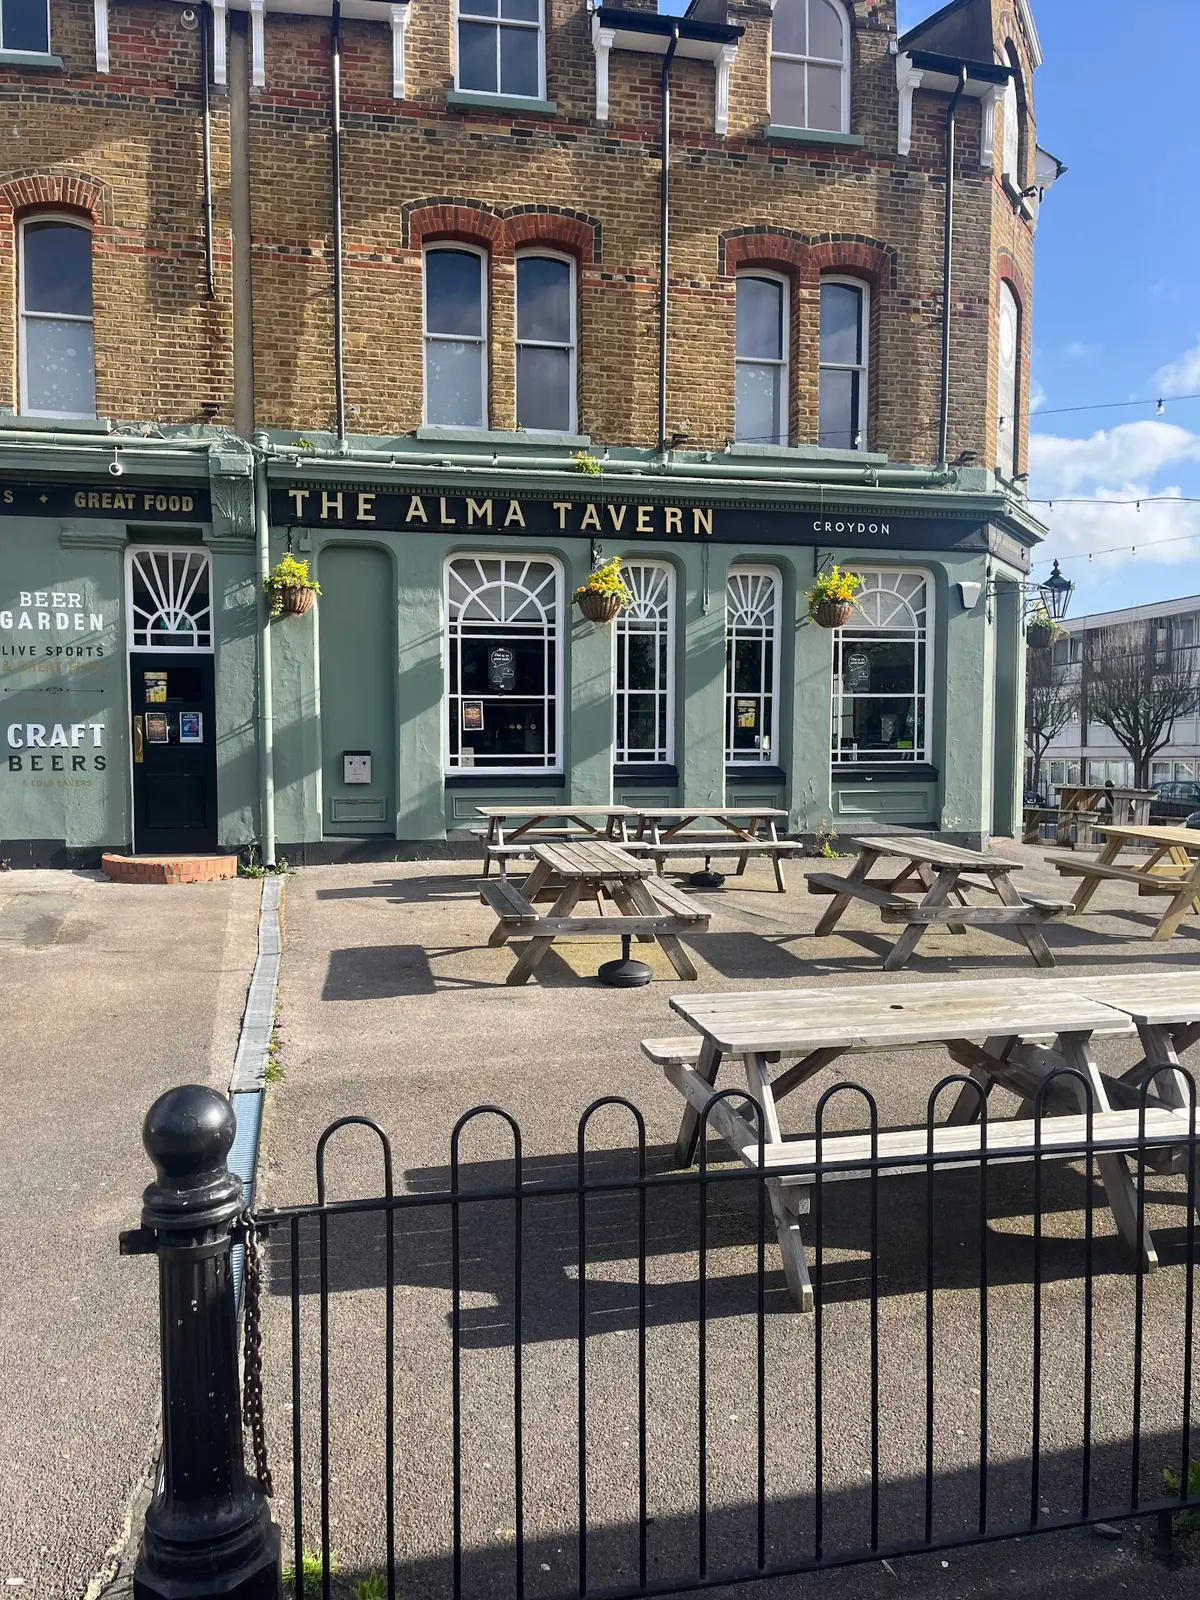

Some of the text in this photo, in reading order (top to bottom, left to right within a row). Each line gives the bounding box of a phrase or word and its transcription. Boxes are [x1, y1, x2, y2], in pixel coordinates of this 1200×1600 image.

[74, 491, 136, 510] GREAT
[144, 494, 194, 512] FOOD
[289, 489, 715, 536] THE ALMA TAVERN
[813, 520, 891, 535] CROYDON
[19, 591, 83, 608] BEER
[0, 610, 104, 631] GARDEN
[1, 645, 105, 657] LIVE SPORTS
[6, 723, 106, 749] CRAFT
[8, 755, 107, 772] BEERS
